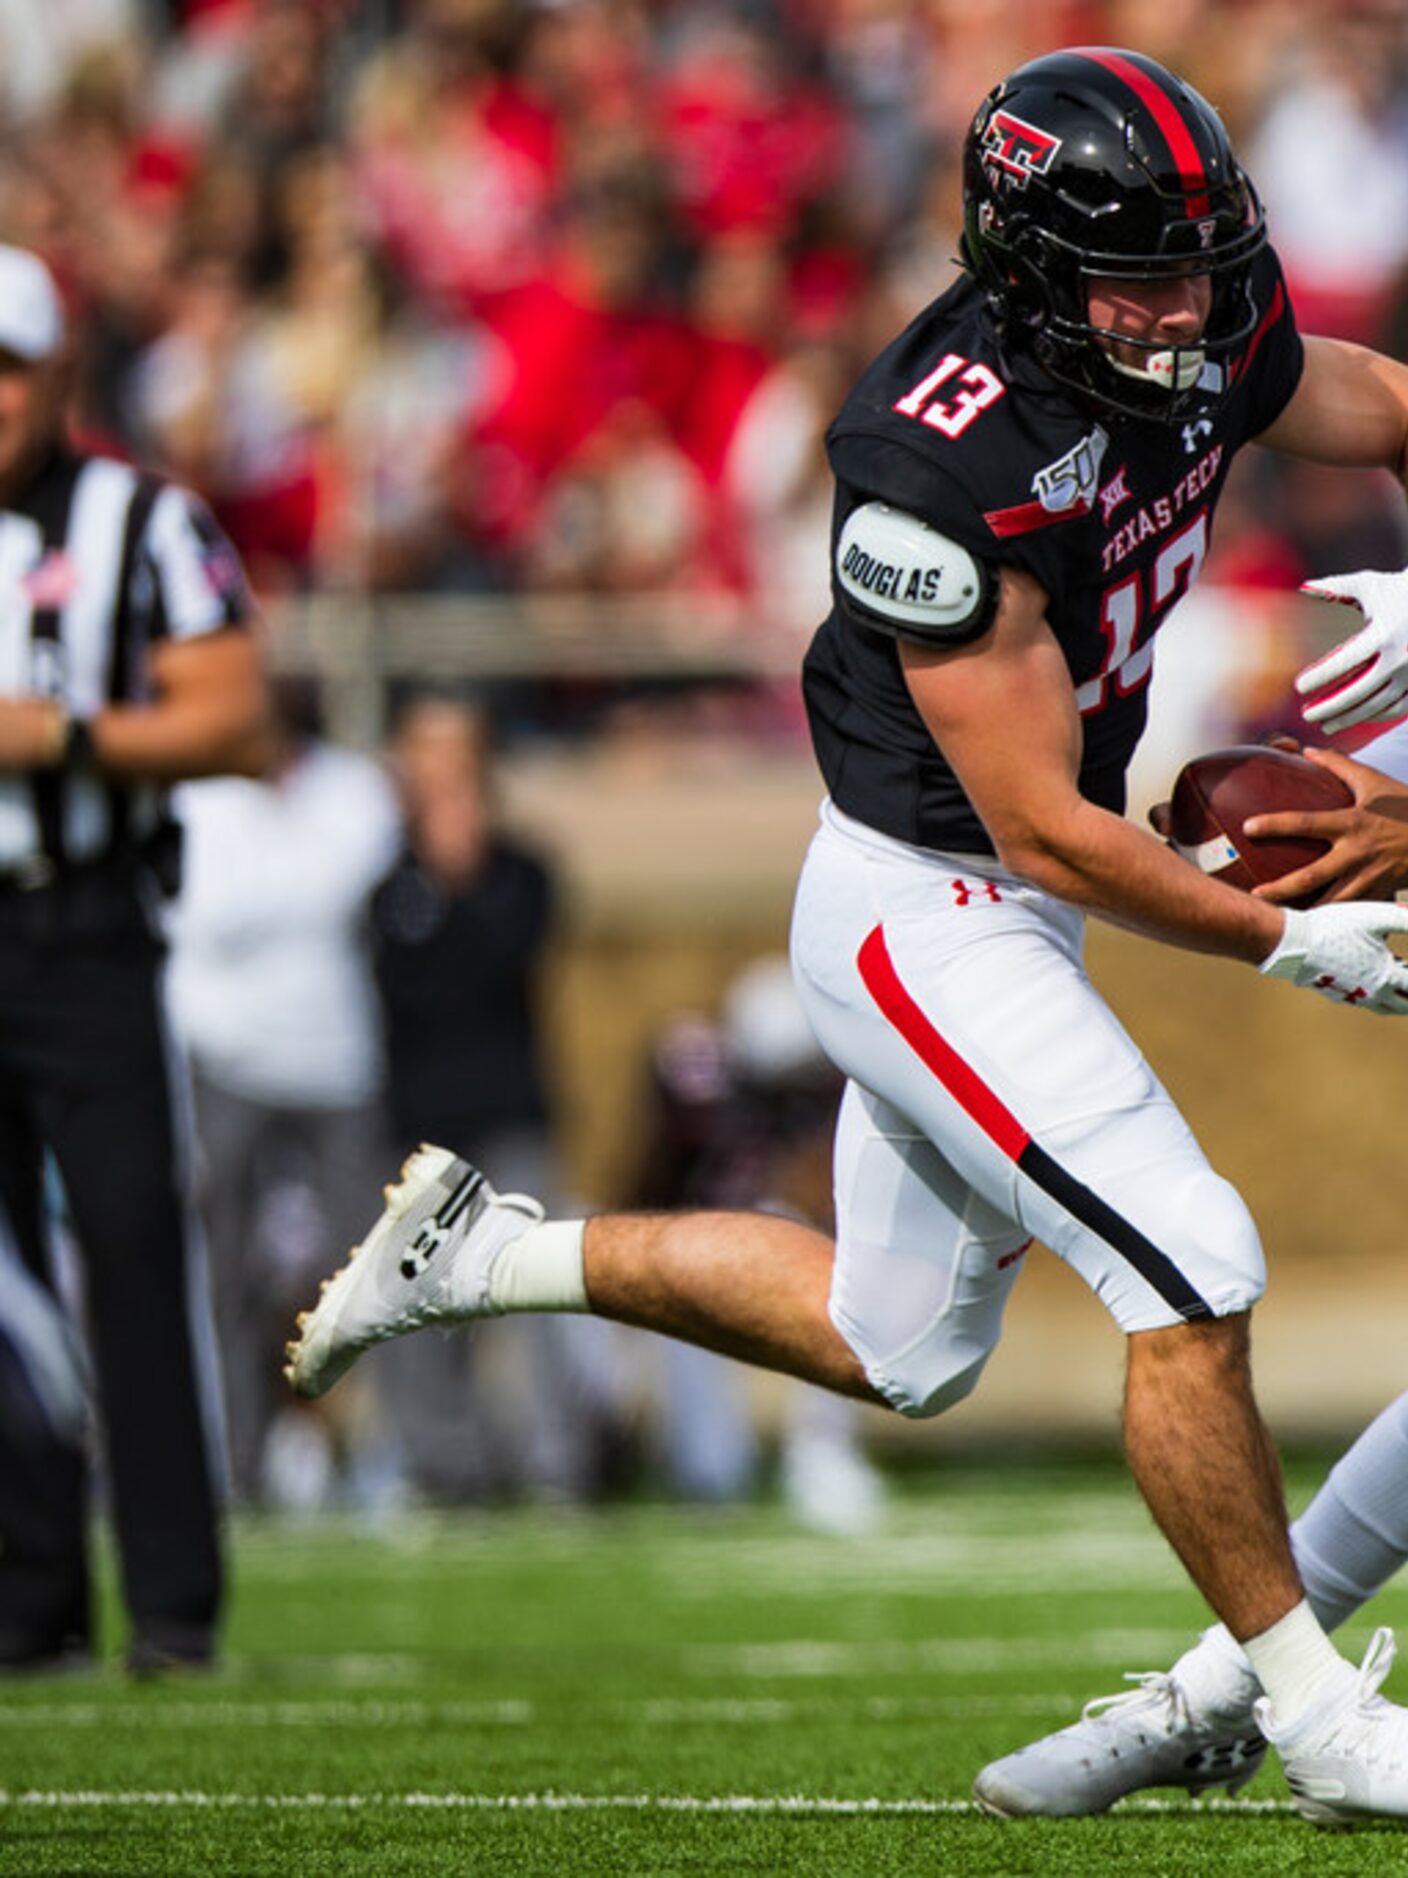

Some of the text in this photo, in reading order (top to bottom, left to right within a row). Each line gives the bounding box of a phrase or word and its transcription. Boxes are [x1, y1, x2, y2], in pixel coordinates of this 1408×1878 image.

[893, 353, 1006, 440] 13
[1032, 437, 1096, 512] 150
[842, 542, 942, 603] DOUGLAS
[1102, 496, 1172, 573] TEXAS
